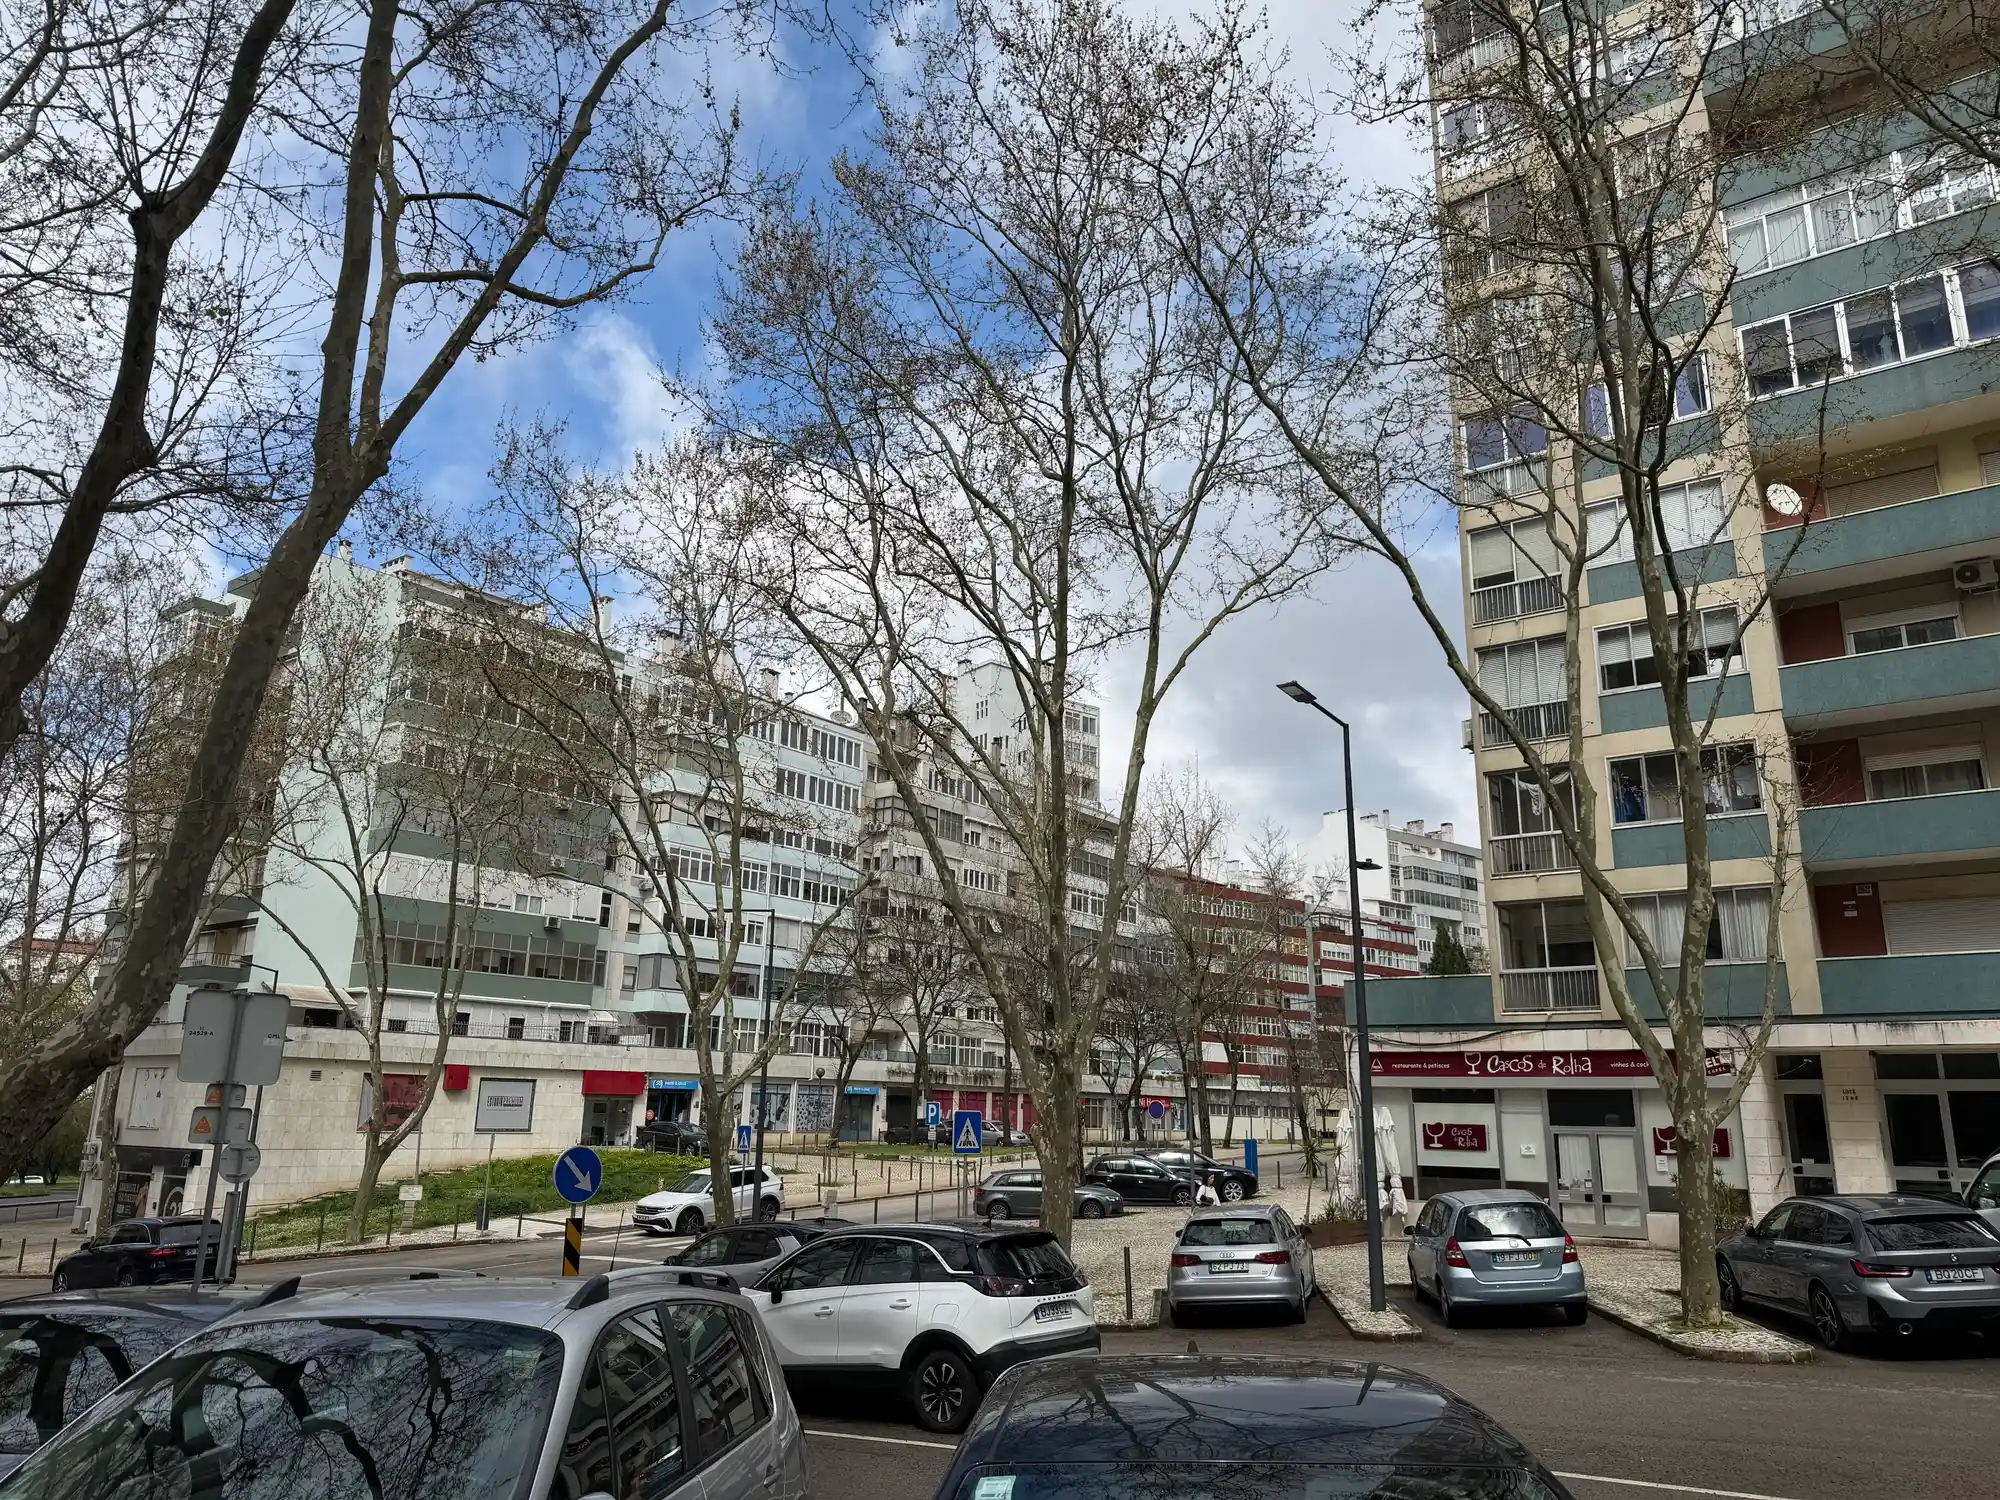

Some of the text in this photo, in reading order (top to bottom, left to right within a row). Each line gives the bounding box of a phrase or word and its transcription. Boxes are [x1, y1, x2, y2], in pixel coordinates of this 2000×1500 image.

[1428, 1062, 1450, 1070] petiscos
[1538, 1059, 1547, 1069] de
[1552, 1053, 1592, 1075] Rolha
[928, 1103, 936, 1123] P
[1934, 1268, 1979, 1280] BQ20CF
